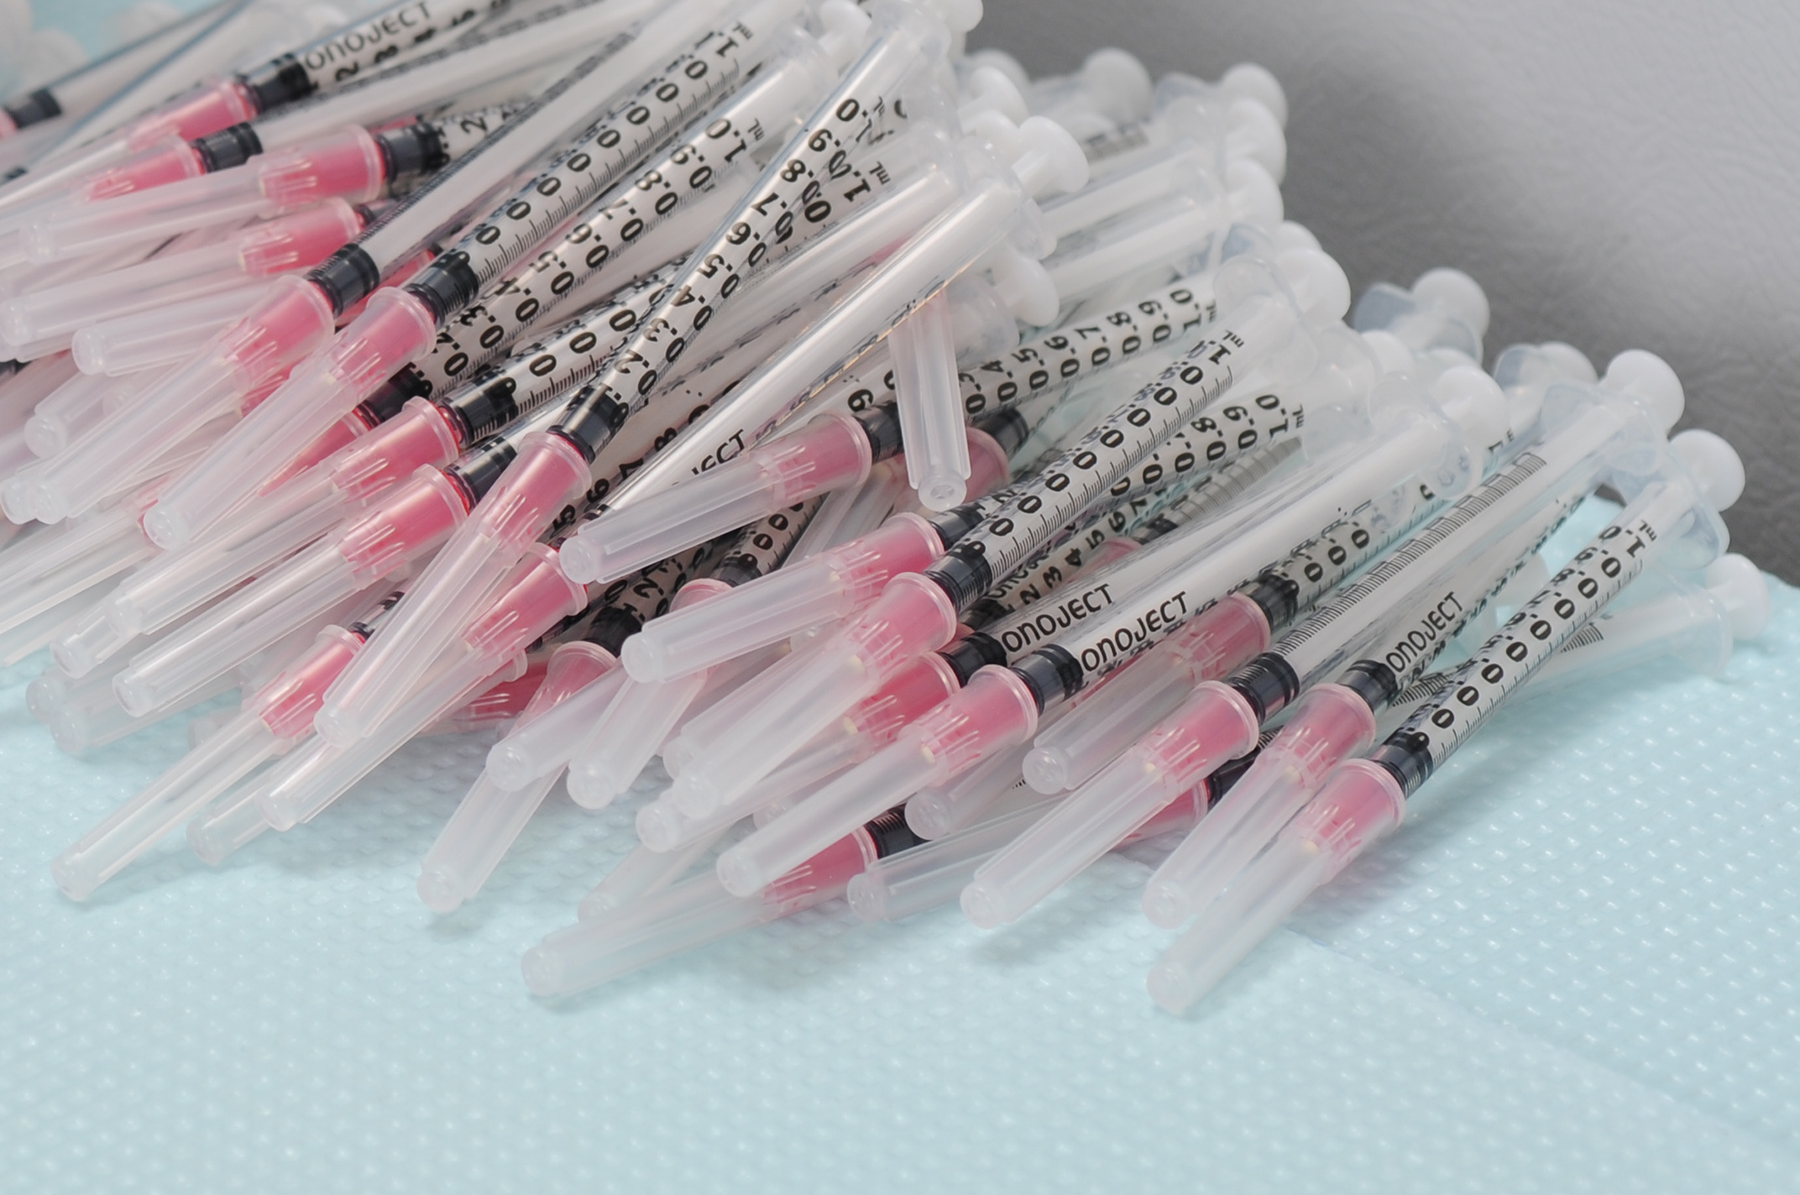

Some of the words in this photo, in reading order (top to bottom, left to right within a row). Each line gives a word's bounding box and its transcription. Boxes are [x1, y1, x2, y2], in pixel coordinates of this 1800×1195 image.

[704, 117, 748, 164] 1.0
[747, 118, 766, 142] mL
[1221, 329, 1245, 348] mL
[1638, 519, 1658, 542] mL
